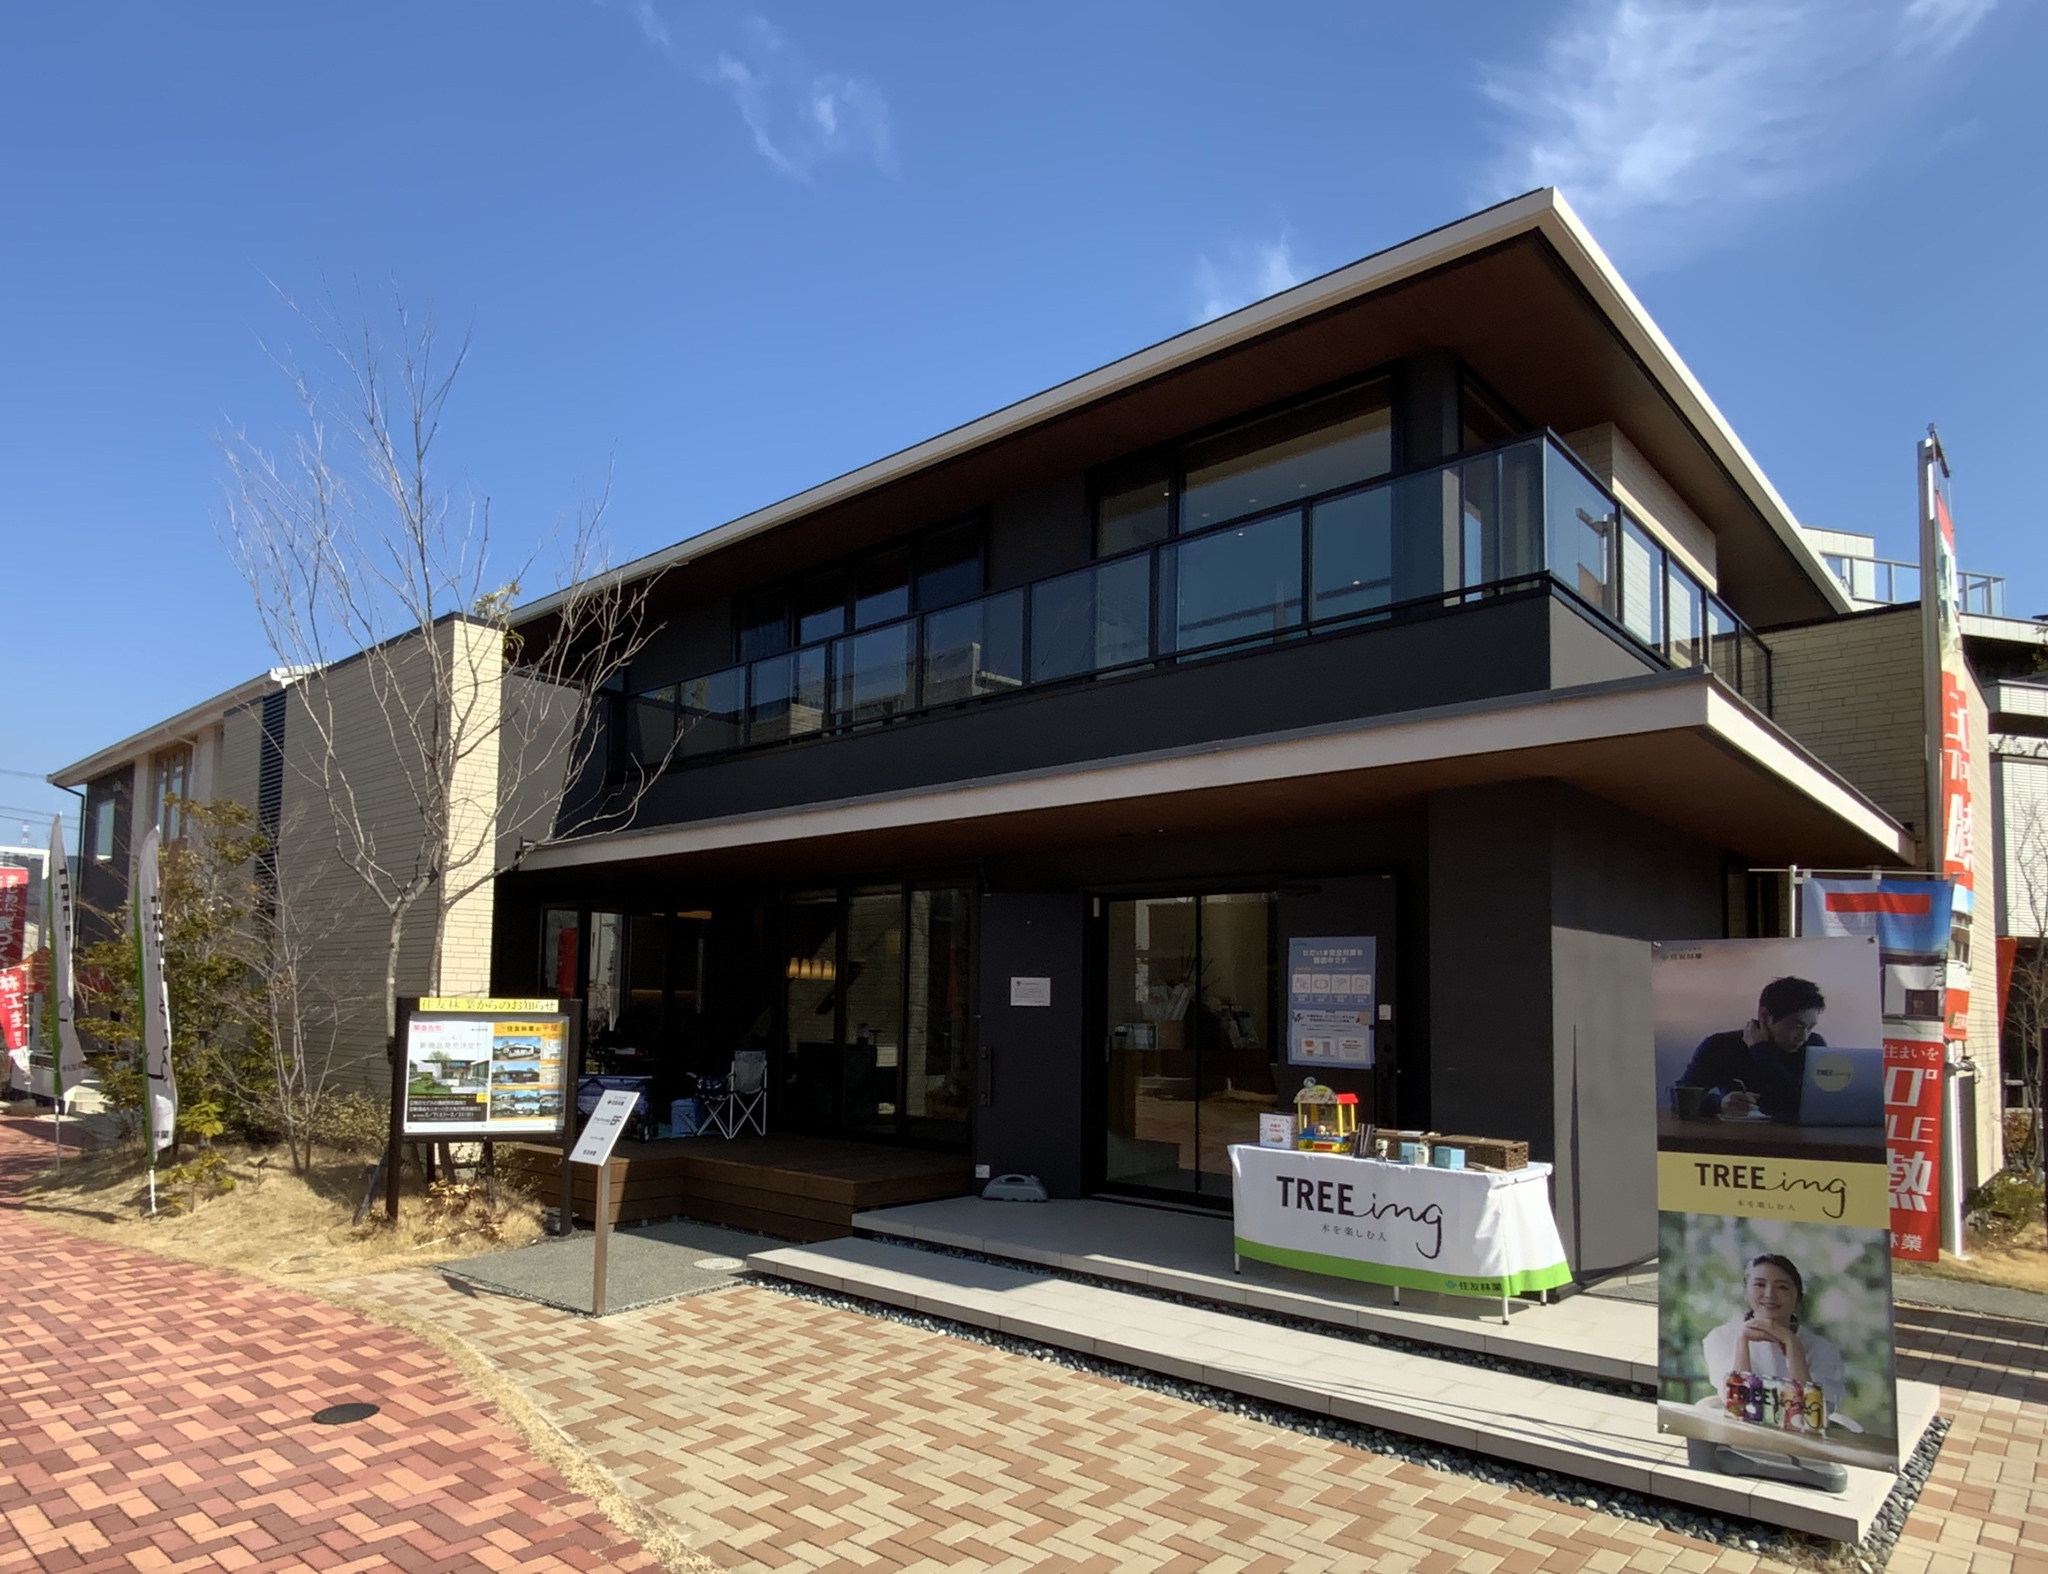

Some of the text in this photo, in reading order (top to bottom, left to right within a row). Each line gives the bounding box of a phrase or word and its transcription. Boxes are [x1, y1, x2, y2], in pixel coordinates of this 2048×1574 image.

[1737, 1200, 1796, 1212] 木を楽しむ人
[1321, 1224, 1387, 1243] 木を楽しむ人
[1458, 1280, 1503, 1293] 住友林業
